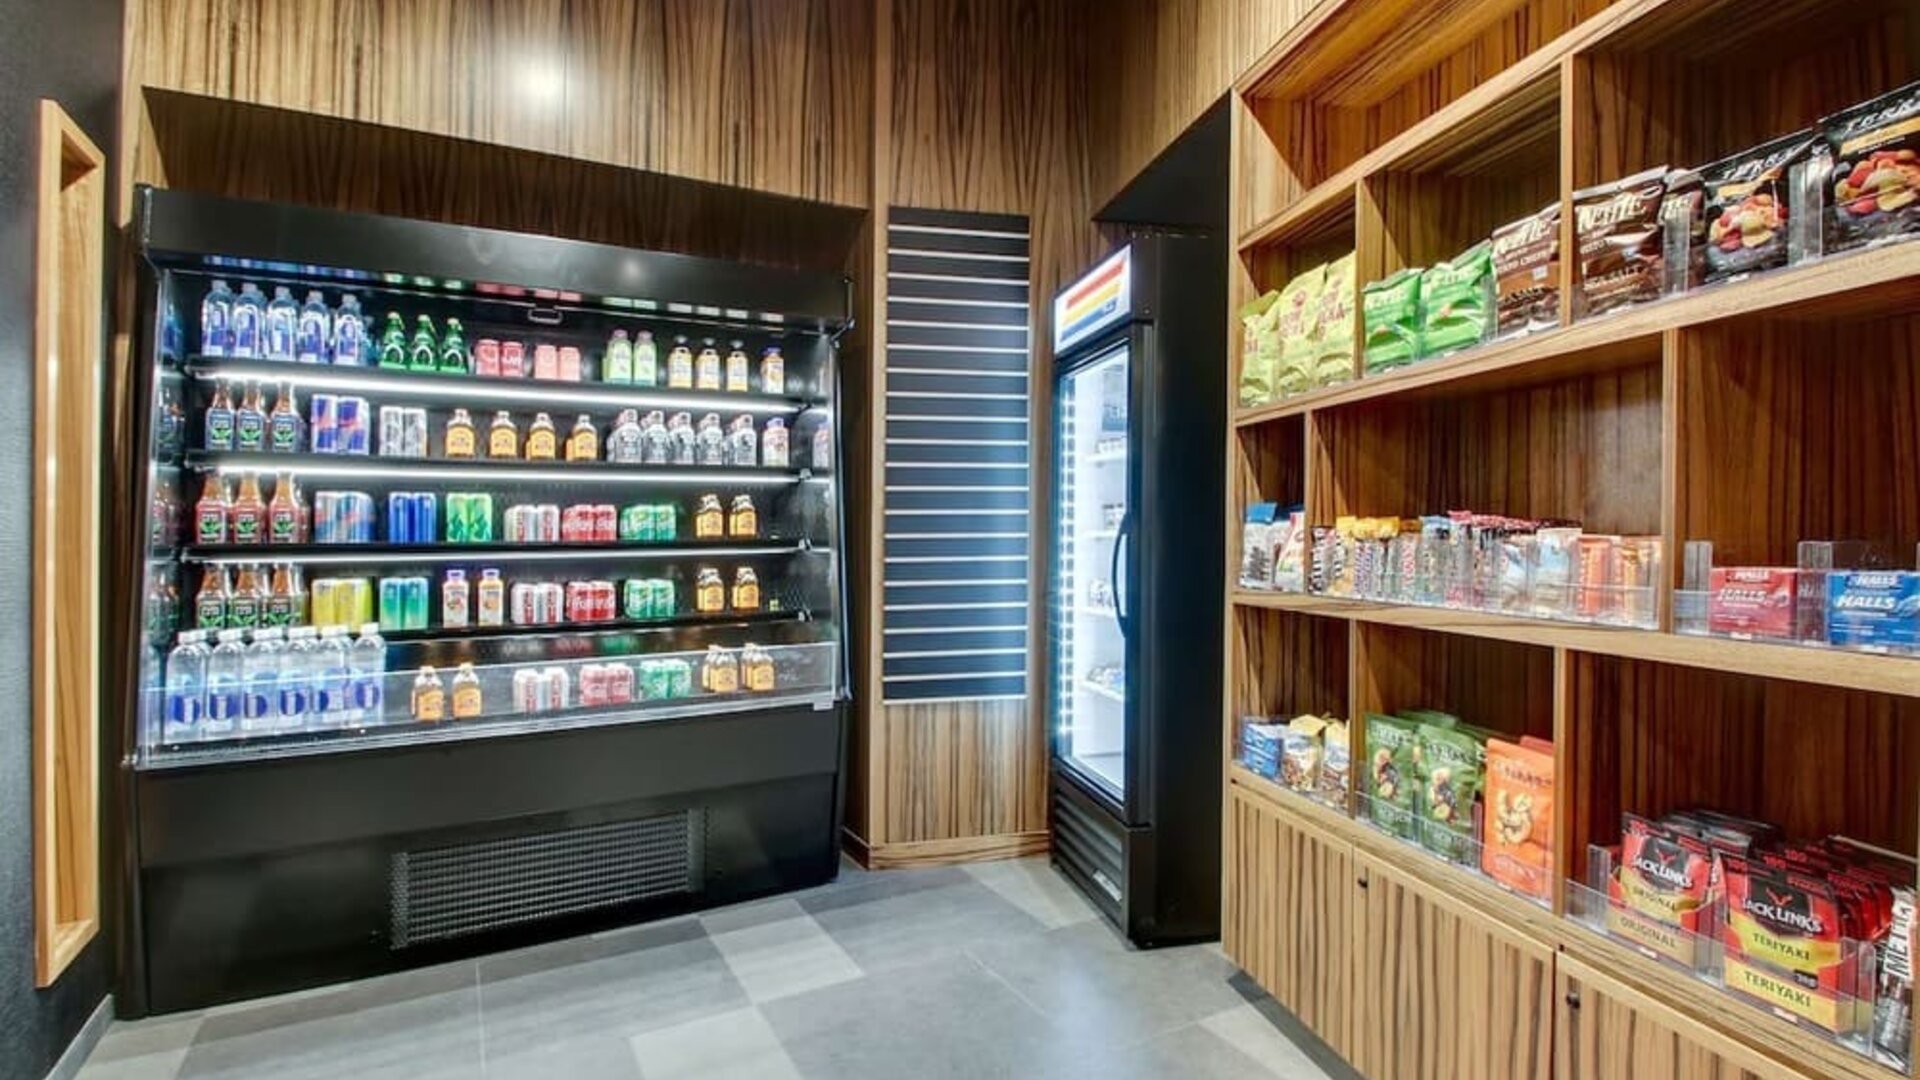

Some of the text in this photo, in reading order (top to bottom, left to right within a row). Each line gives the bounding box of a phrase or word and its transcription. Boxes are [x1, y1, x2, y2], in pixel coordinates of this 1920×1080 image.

[1836, 595, 1896, 610] HALLS
[1620, 917, 1678, 948] ORIGINAL
[1752, 931, 1811, 962] TERIYAKI
[1744, 970, 1812, 1008] TERIYAKI
